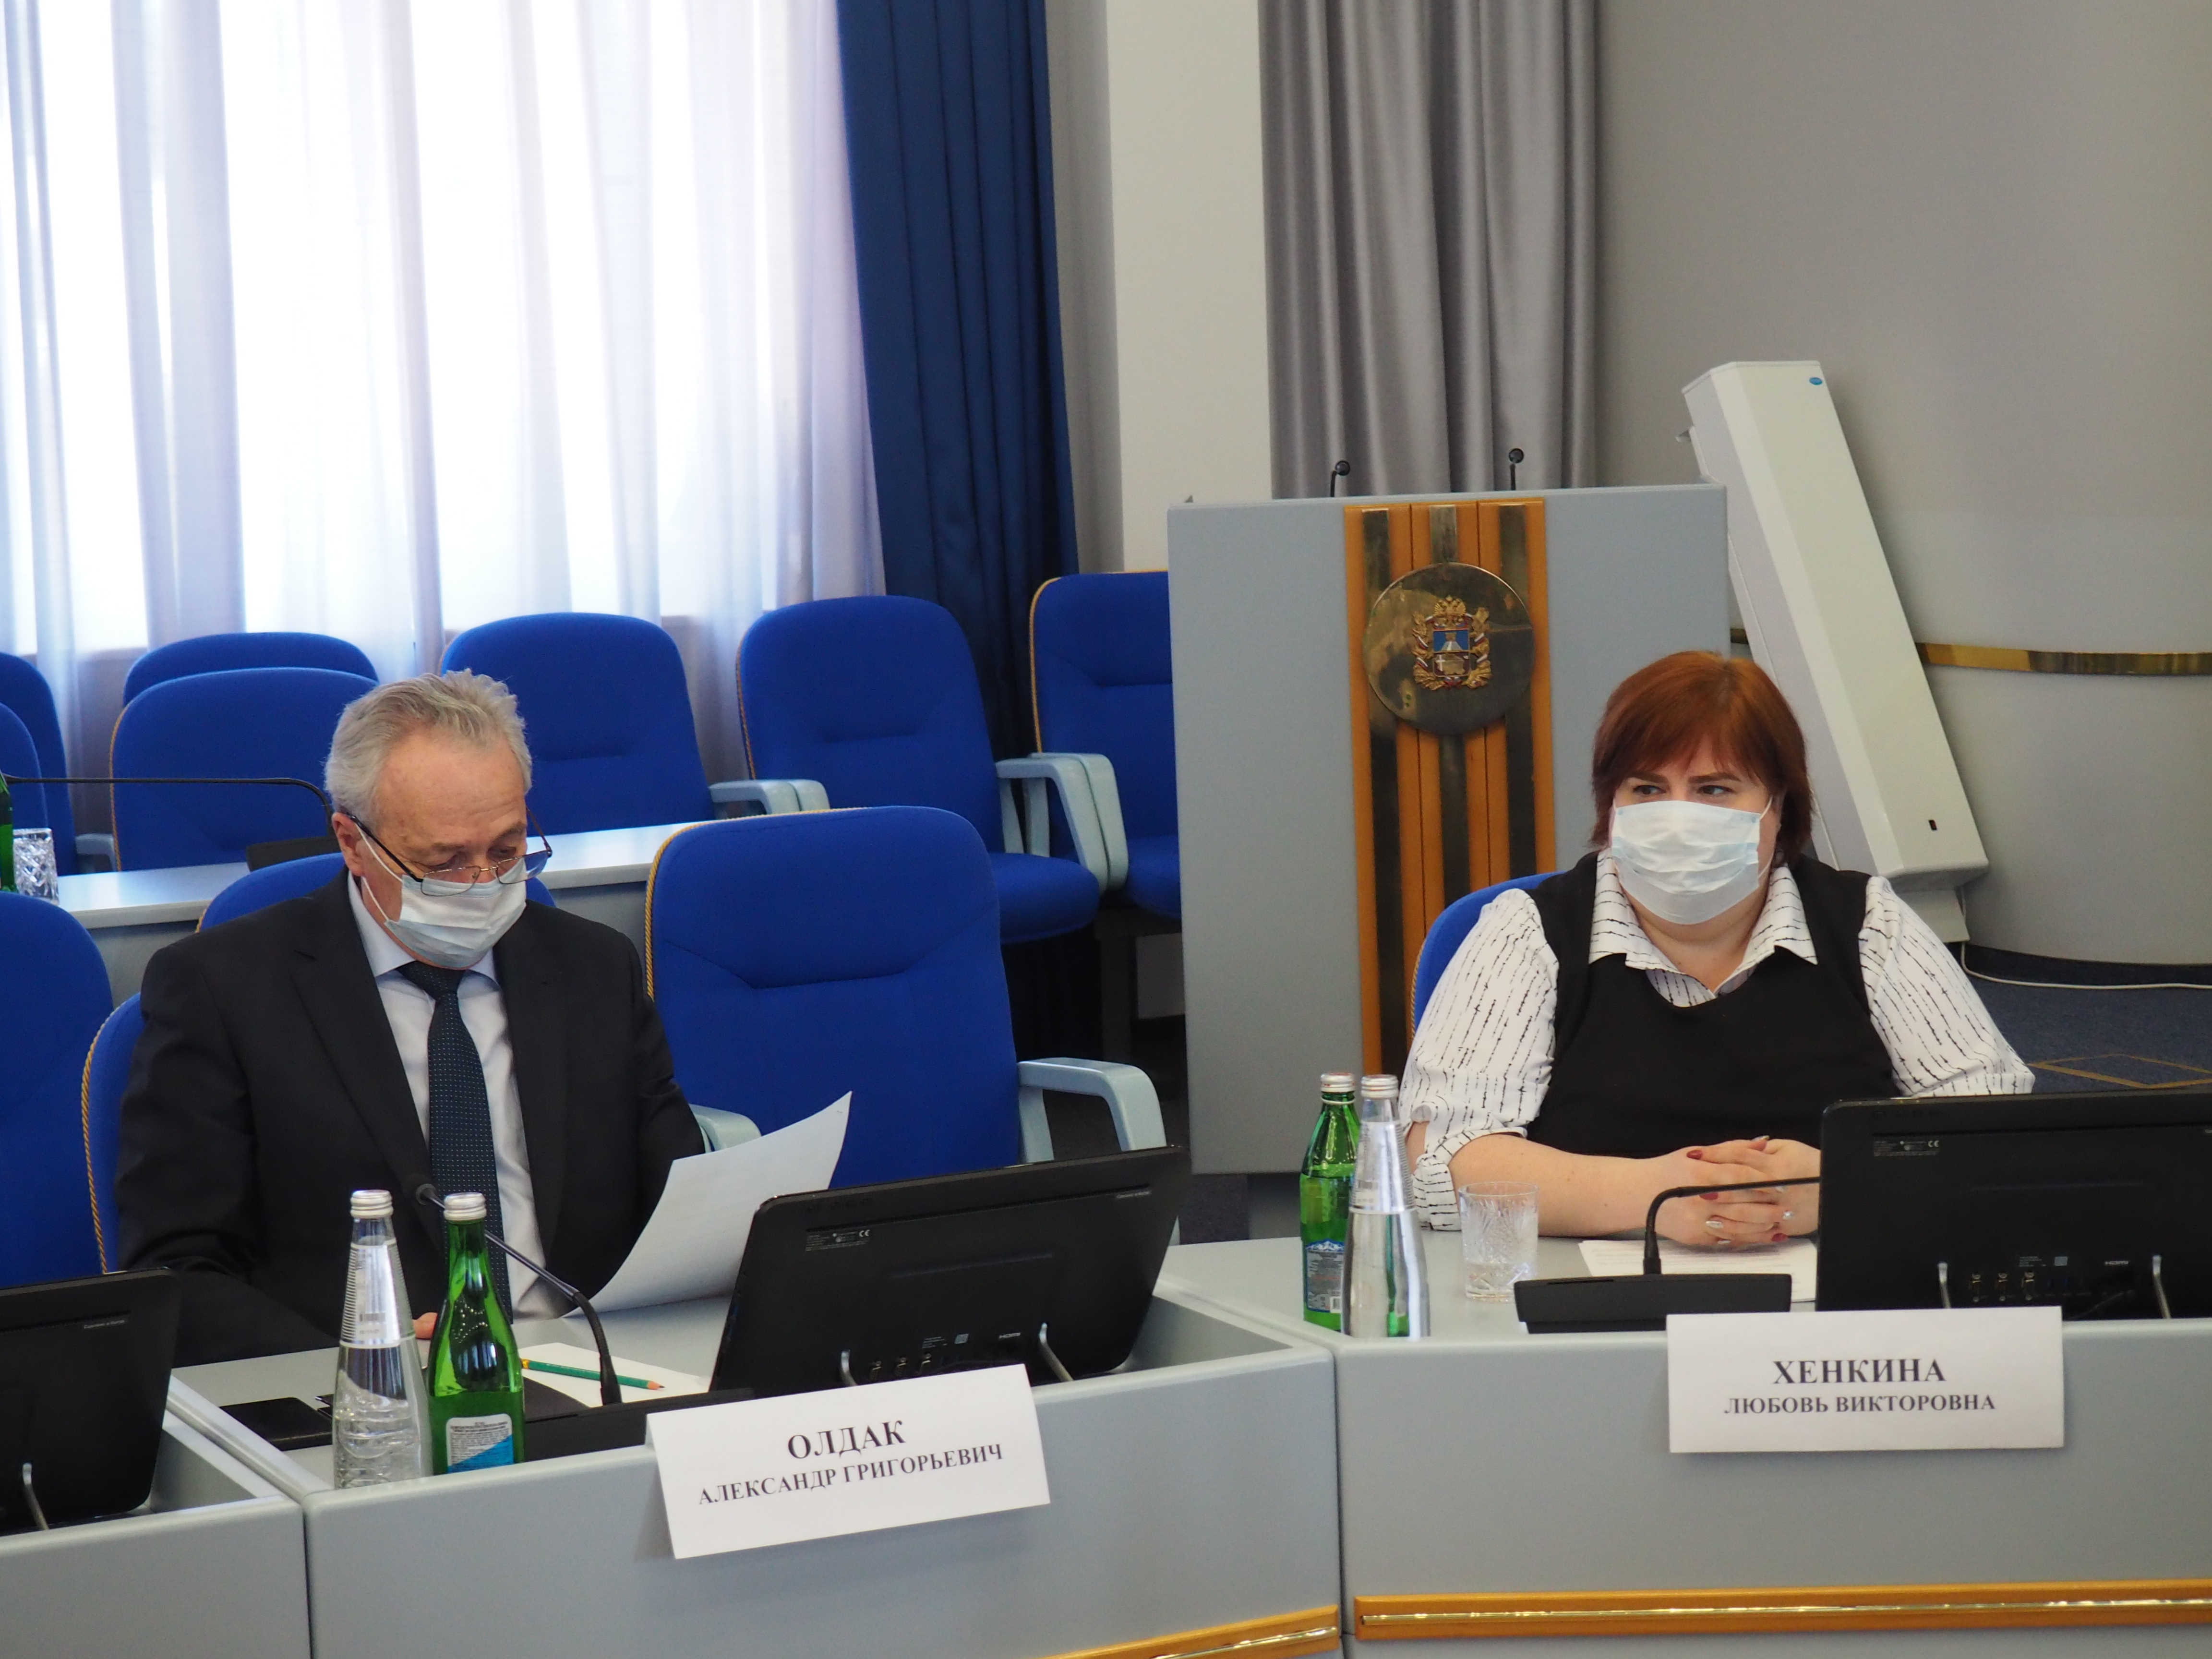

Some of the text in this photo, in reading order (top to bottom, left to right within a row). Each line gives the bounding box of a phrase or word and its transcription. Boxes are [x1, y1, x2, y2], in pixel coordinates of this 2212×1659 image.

[1773, 1358, 1947, 1384] ХЕНКИНА
[1724, 1394, 1996, 1414] ЛЮБОВЬ ВИКТОРОВНА
[787, 1420, 906, 1459] ОЛДАК
[698, 1443, 1004, 1505] АЛЕКСАНДР ГРИГОРЬЕВИЧ
